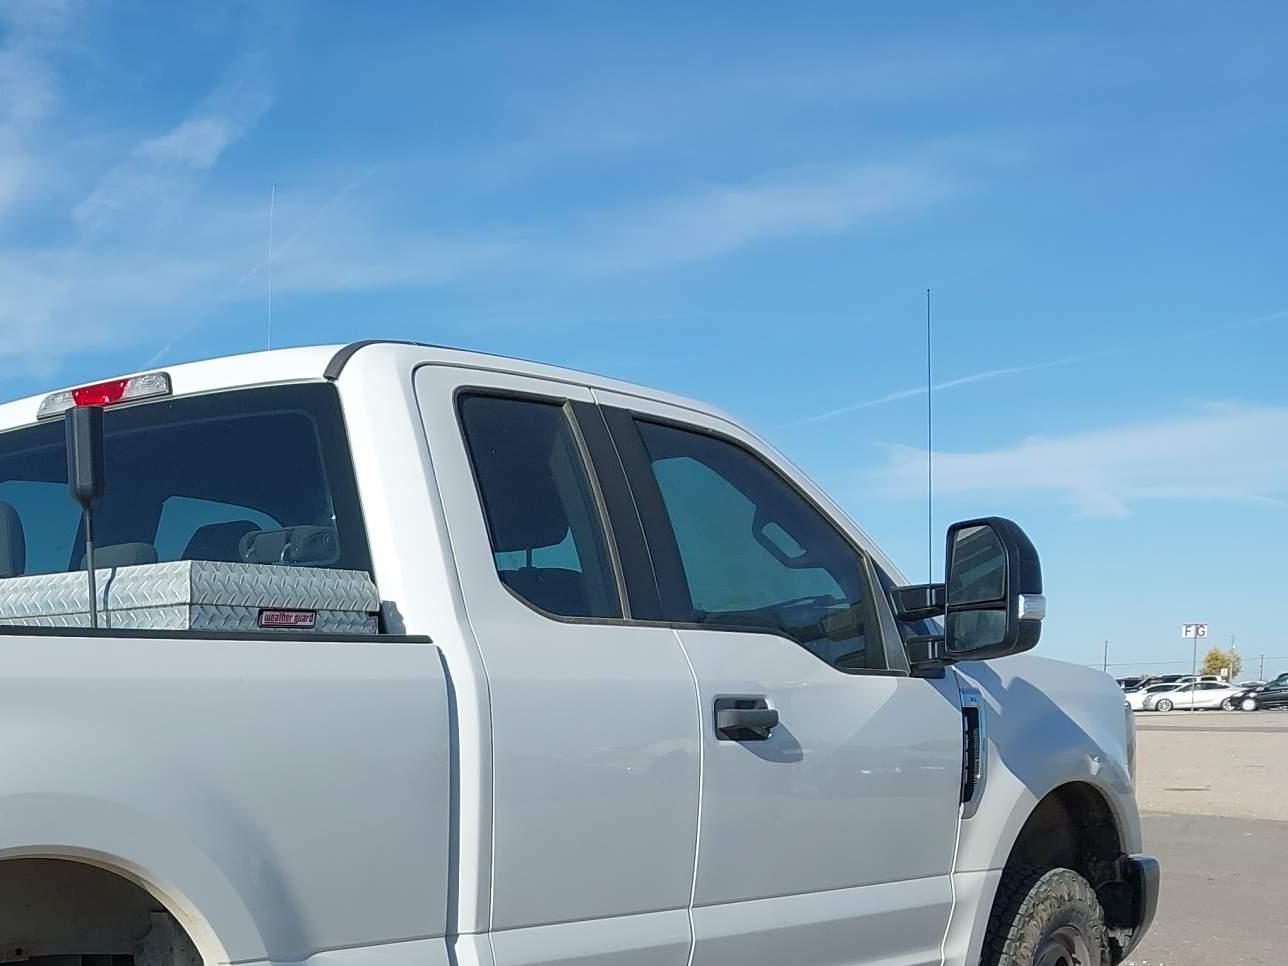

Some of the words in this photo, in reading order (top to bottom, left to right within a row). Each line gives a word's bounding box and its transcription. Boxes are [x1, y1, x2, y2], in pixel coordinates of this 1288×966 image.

[264, 612, 294, 623] weather
[295, 612, 314, 624] guard
[1184, 625, 1192, 637] F
[1197, 624, 1206, 637] G
